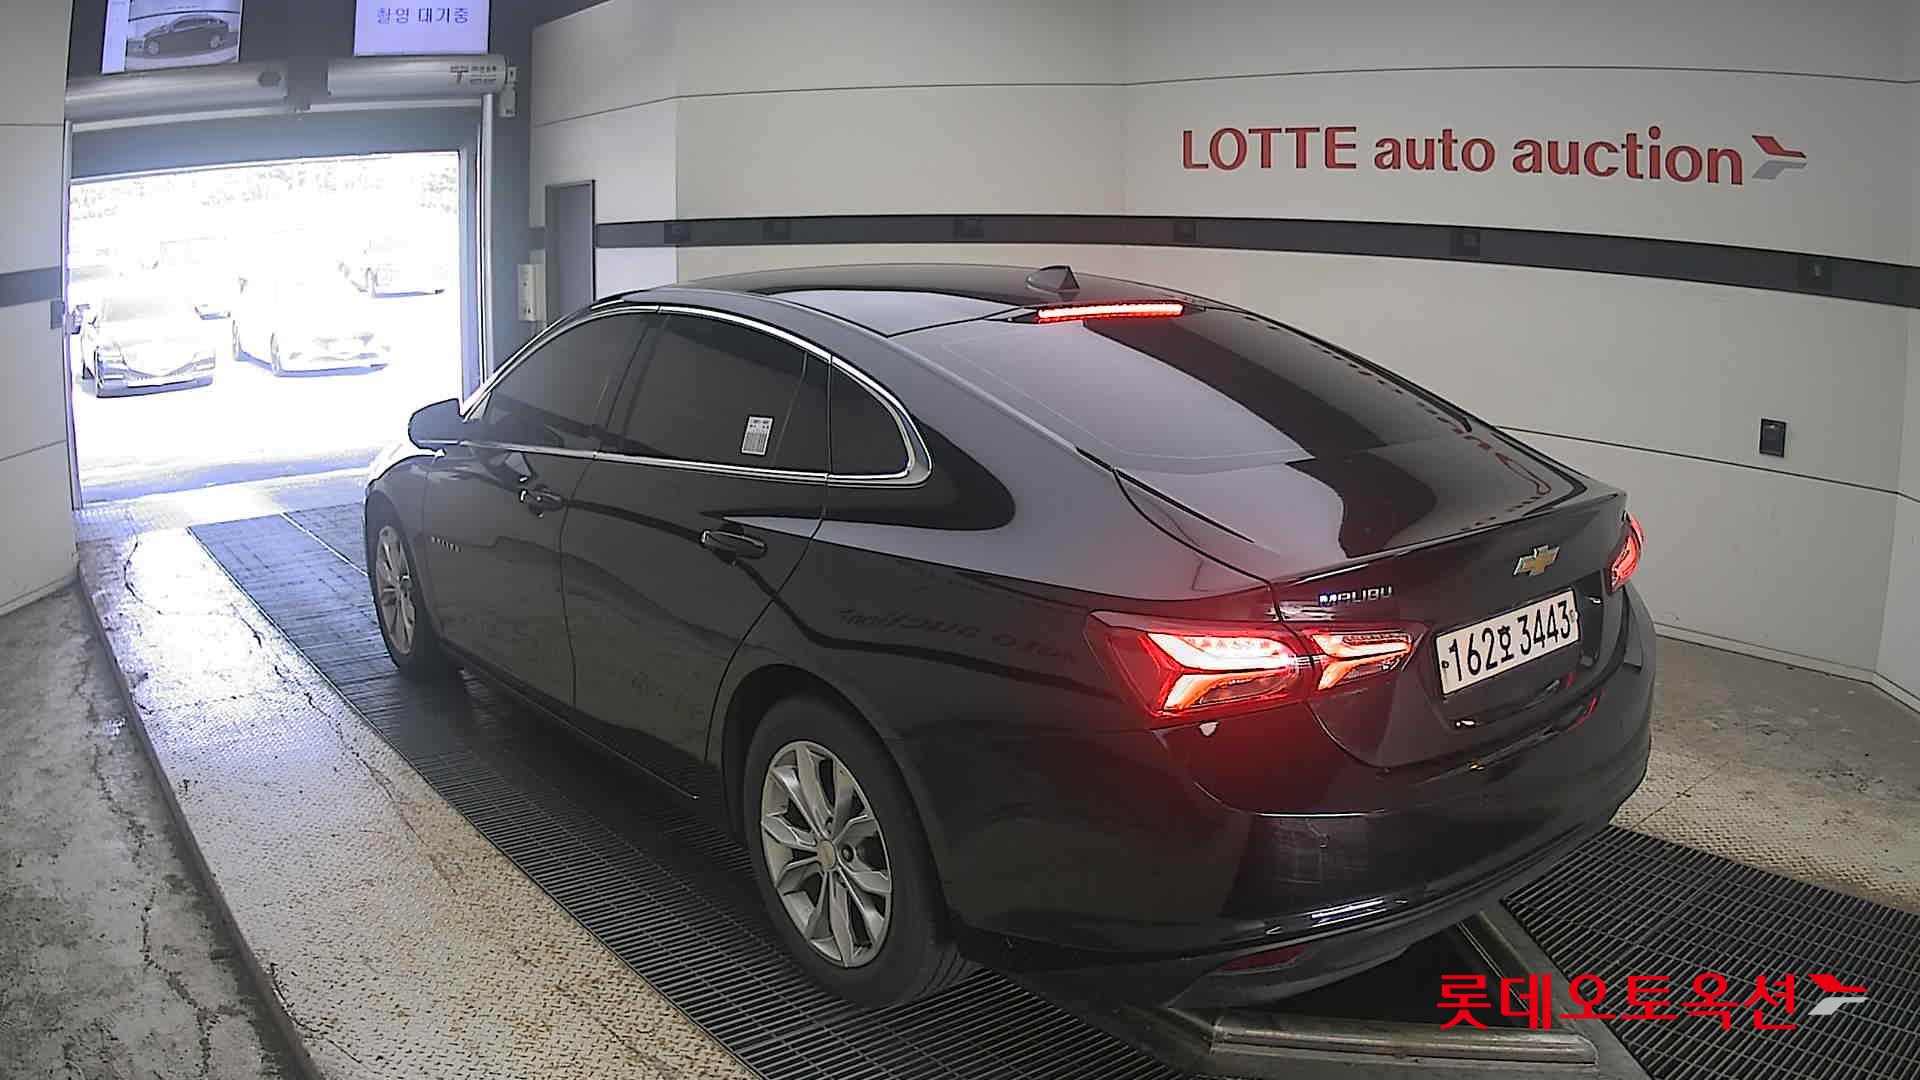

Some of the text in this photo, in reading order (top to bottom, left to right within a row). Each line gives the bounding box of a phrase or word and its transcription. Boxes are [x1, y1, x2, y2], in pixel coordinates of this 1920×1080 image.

[418, 7, 471, 24] 대기중
[1182, 126, 1743, 185] LOTTE auto auction
[1449, 600, 1571, 682] 162호 3443
